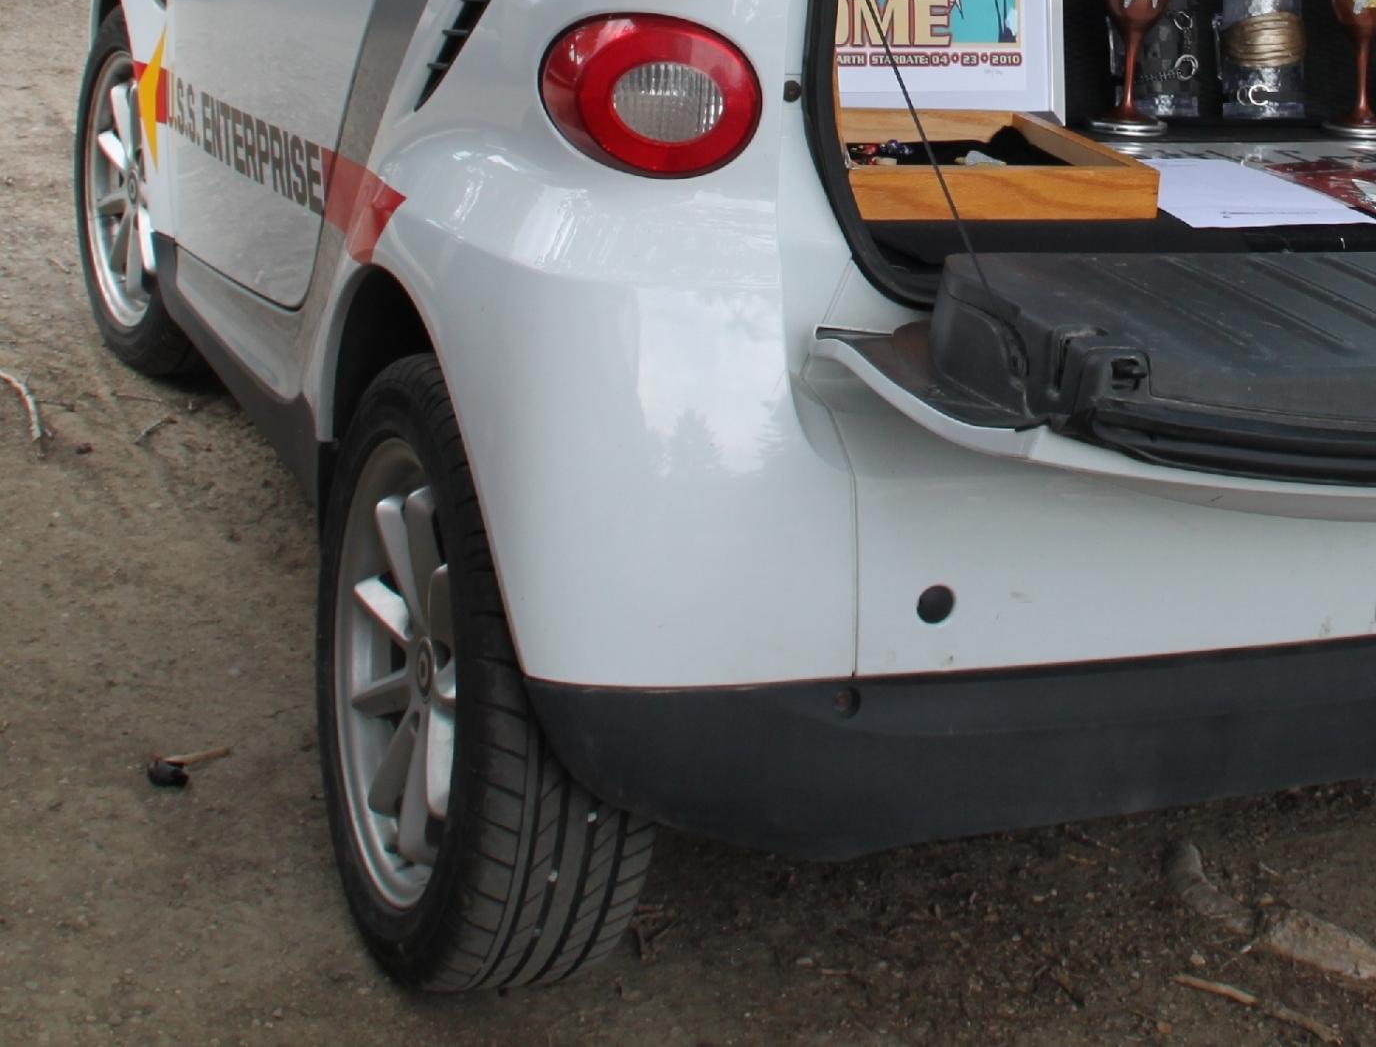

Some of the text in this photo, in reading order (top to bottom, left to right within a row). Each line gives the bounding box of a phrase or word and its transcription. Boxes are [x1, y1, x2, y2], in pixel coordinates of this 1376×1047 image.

[837, 55, 866, 65] ARTH
[932, 55, 948, 65] 04
[962, 55, 977, 65] 23
[991, 55, 1021, 65] 2010
[201, 90, 326, 217] ENTERPRISE
